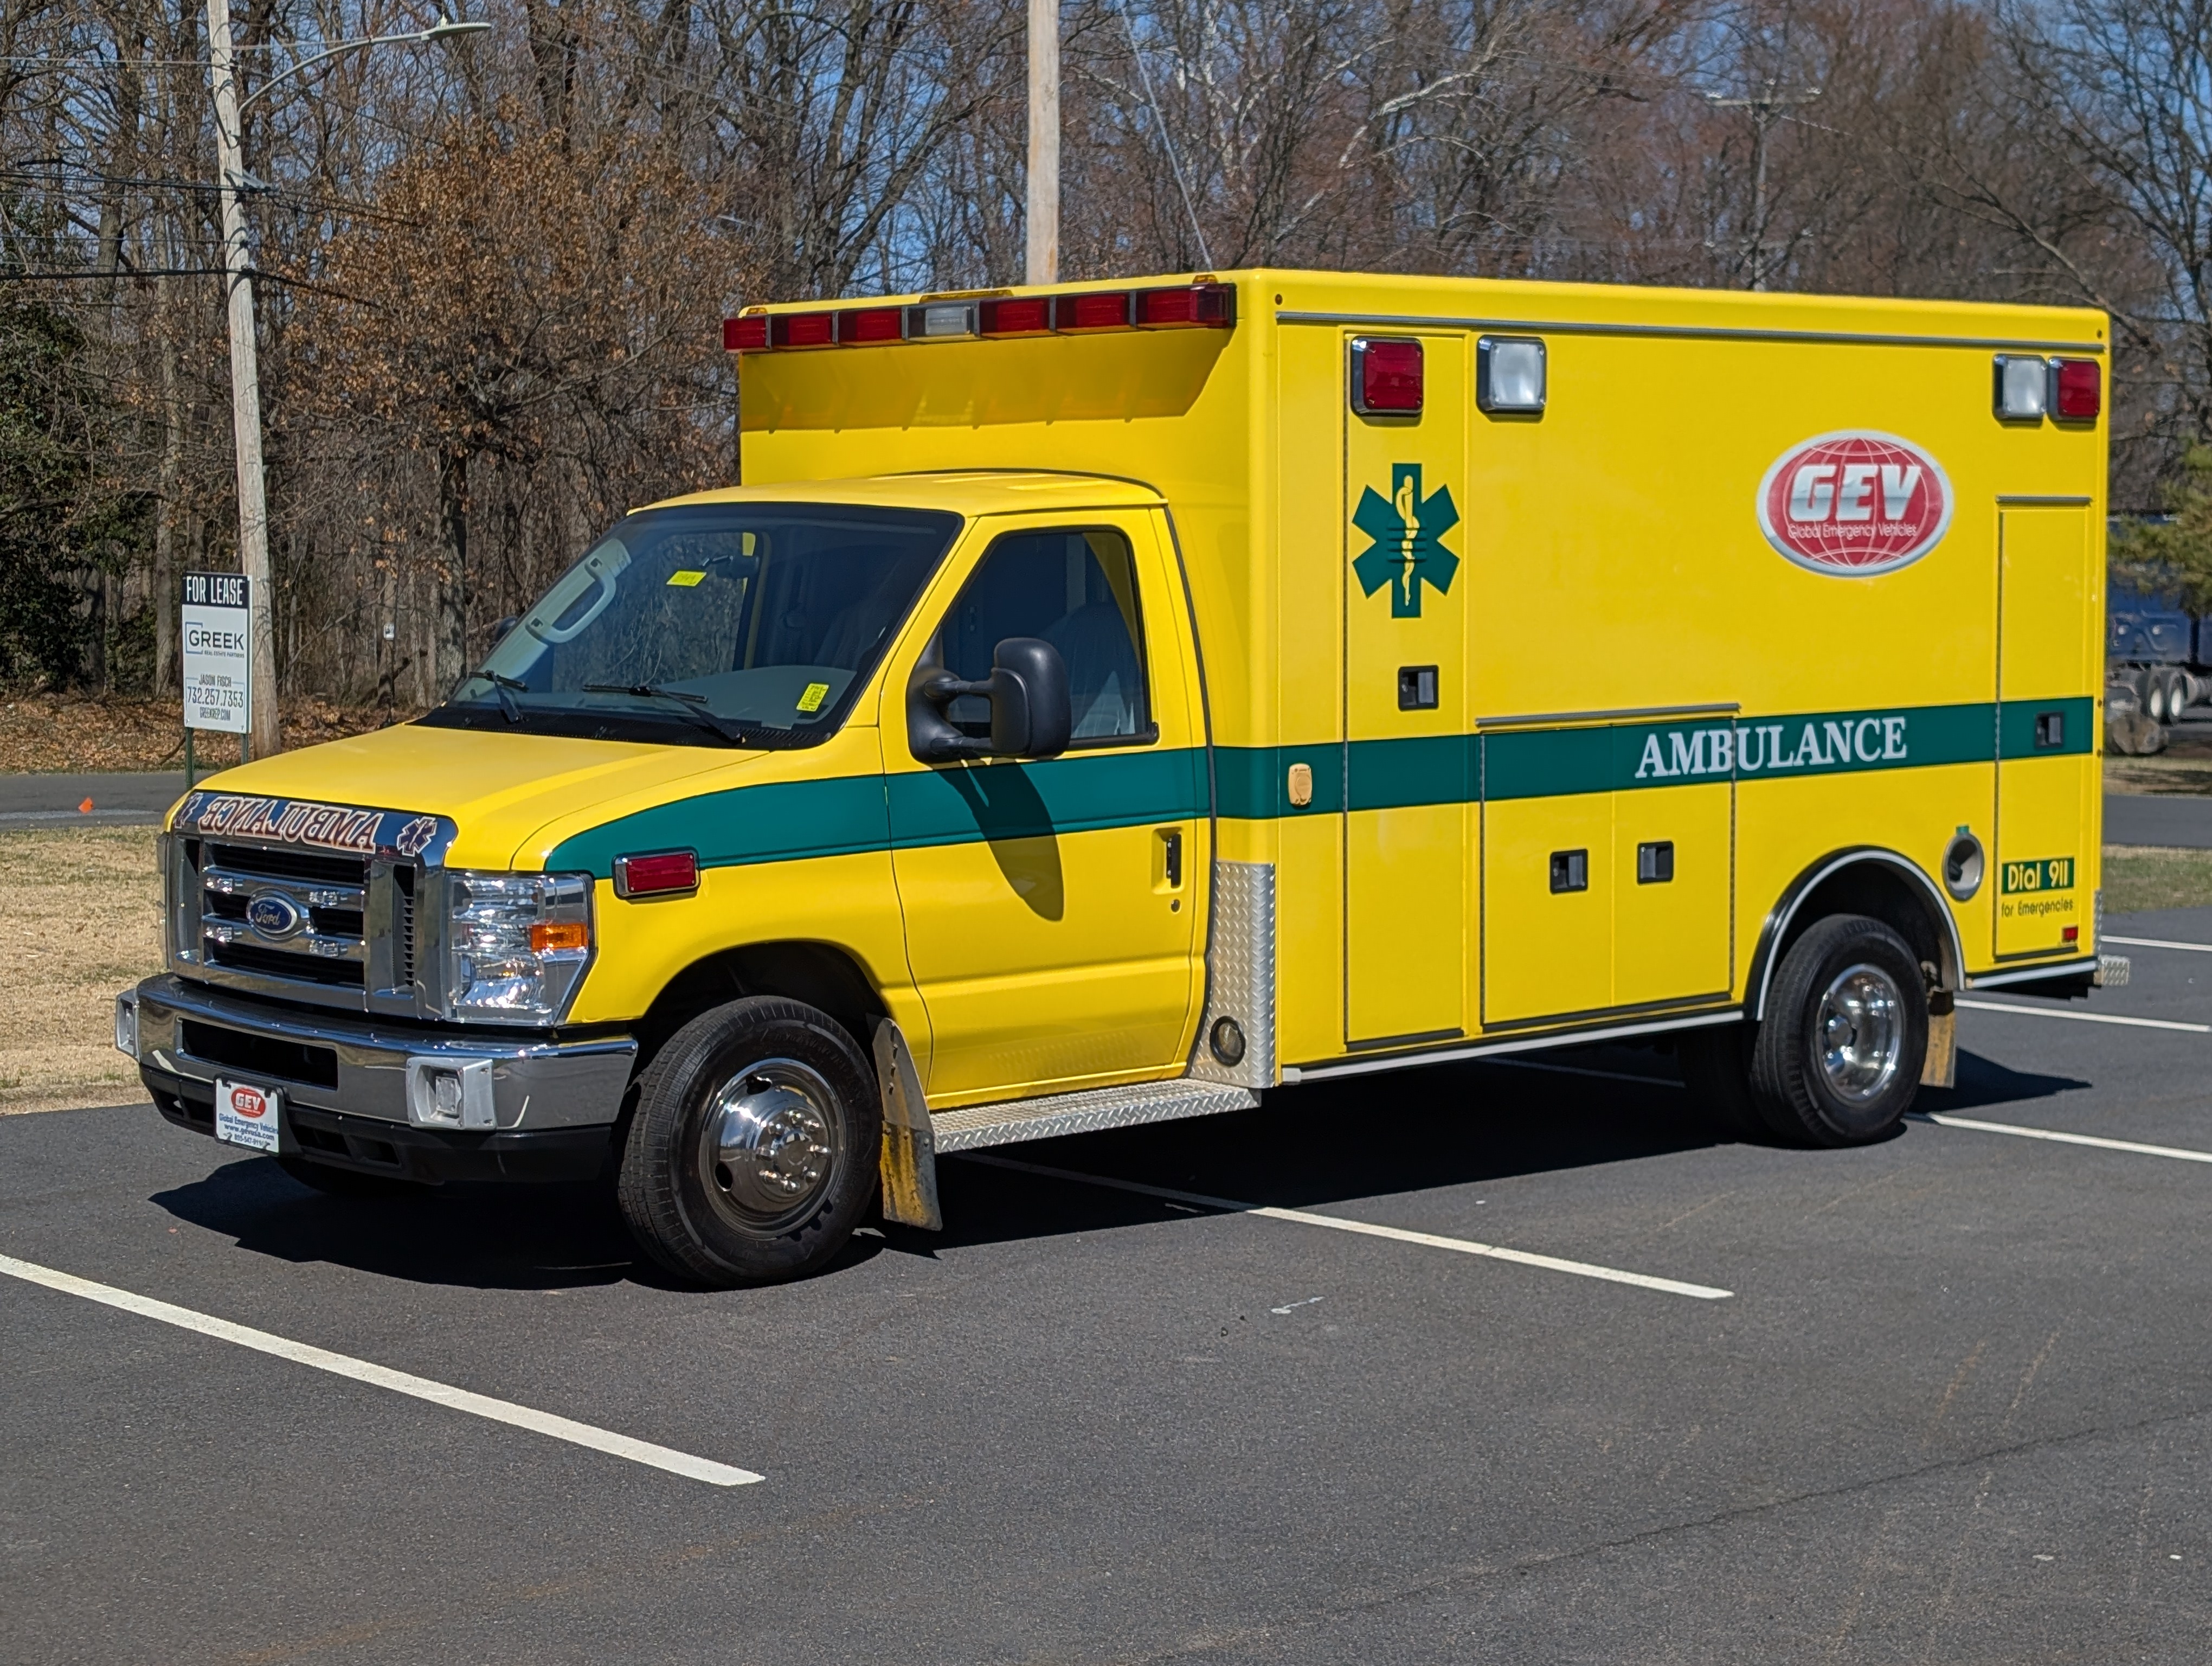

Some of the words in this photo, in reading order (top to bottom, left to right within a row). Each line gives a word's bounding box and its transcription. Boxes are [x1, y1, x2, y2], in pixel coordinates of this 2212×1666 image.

[1789, 464, 1921, 522] GEV
[1789, 523, 1821, 539] Global
[1823, 523, 1875, 540] Emergency
[1878, 522, 1917, 537] Vehicles
[186, 576, 207, 603] FOR
[210, 577, 243, 605] LEASE
[189, 630, 244, 650] GREEK
[199, 674, 215, 685] JASON
[217, 675, 232, 687] FISCH
[188, 686, 243, 708] 732.257.7353
[1635, 716, 1907, 778] AMBULANCE
[2008, 862, 2041, 892] Dial
[2048, 860, 2069, 888] 911
[255, 903, 281, 925] Ford
[2001, 902, 2014, 918] for
[2018, 897, 2073, 917] Emergencies
[235, 1093, 261, 1110] GEV
[219, 1113, 233, 1123] Global
[235, 1116, 259, 1131] Emergency
[224, 1124, 275, 1140] www.gevusa.com
